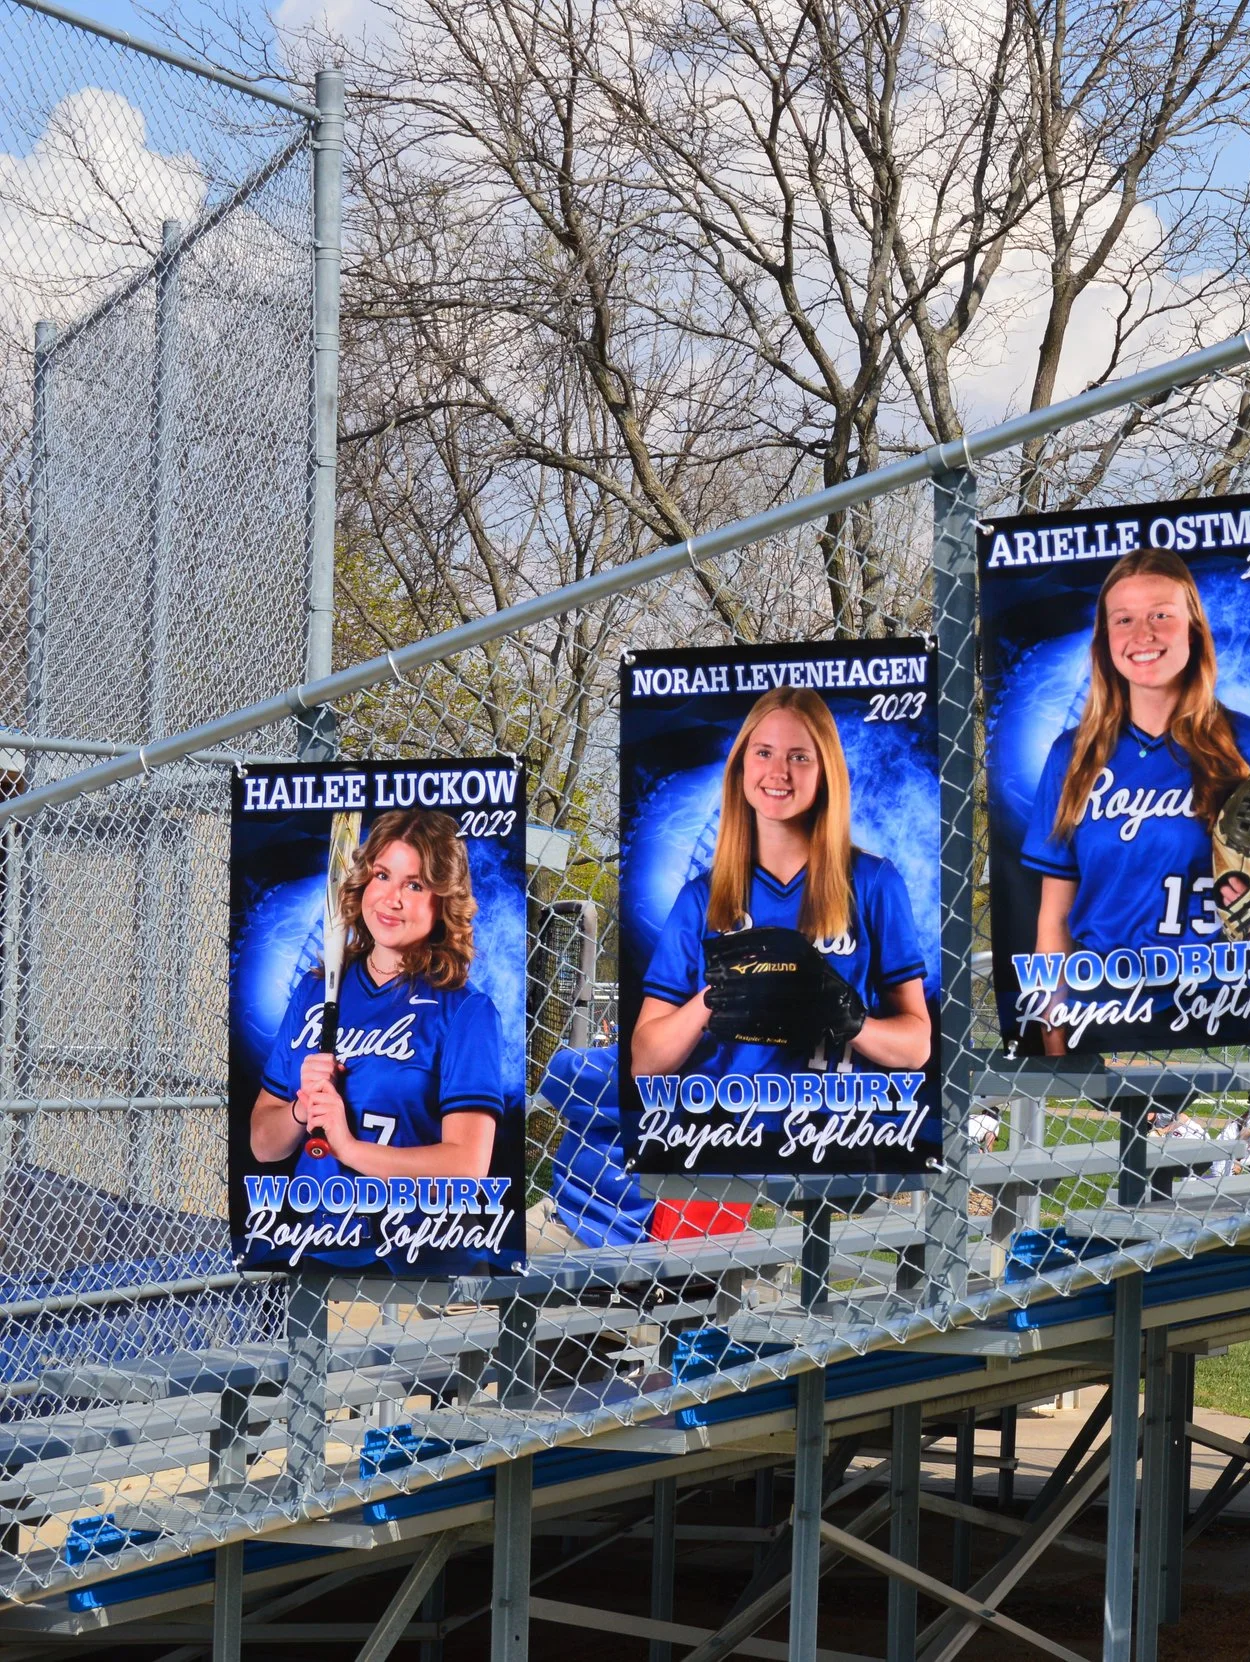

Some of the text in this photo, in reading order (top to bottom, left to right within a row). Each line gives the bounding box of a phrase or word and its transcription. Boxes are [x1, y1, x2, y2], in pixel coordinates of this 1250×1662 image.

[988, 520, 1140, 568] ARIELLE
[632, 655, 927, 695] NORAH LEVENHAGEN
[863, 691, 925, 722] 2023
[244, 770, 516, 810] HAILEE LUCKOW
[456, 810, 515, 838] 2023
[1158, 876, 1223, 935] 13
[752, 961, 797, 974] MIZUNO
[1014, 976, 1153, 1050] Royals
[291, 1003, 416, 1064] Ryals
[635, 1072, 925, 1113] WOODBURY
[362, 1112, 397, 1147] 7
[638, 1103, 929, 1168] Royals Softball
[244, 1175, 511, 1215] WOODBURY
[245, 1204, 515, 1265] Royals Softball
